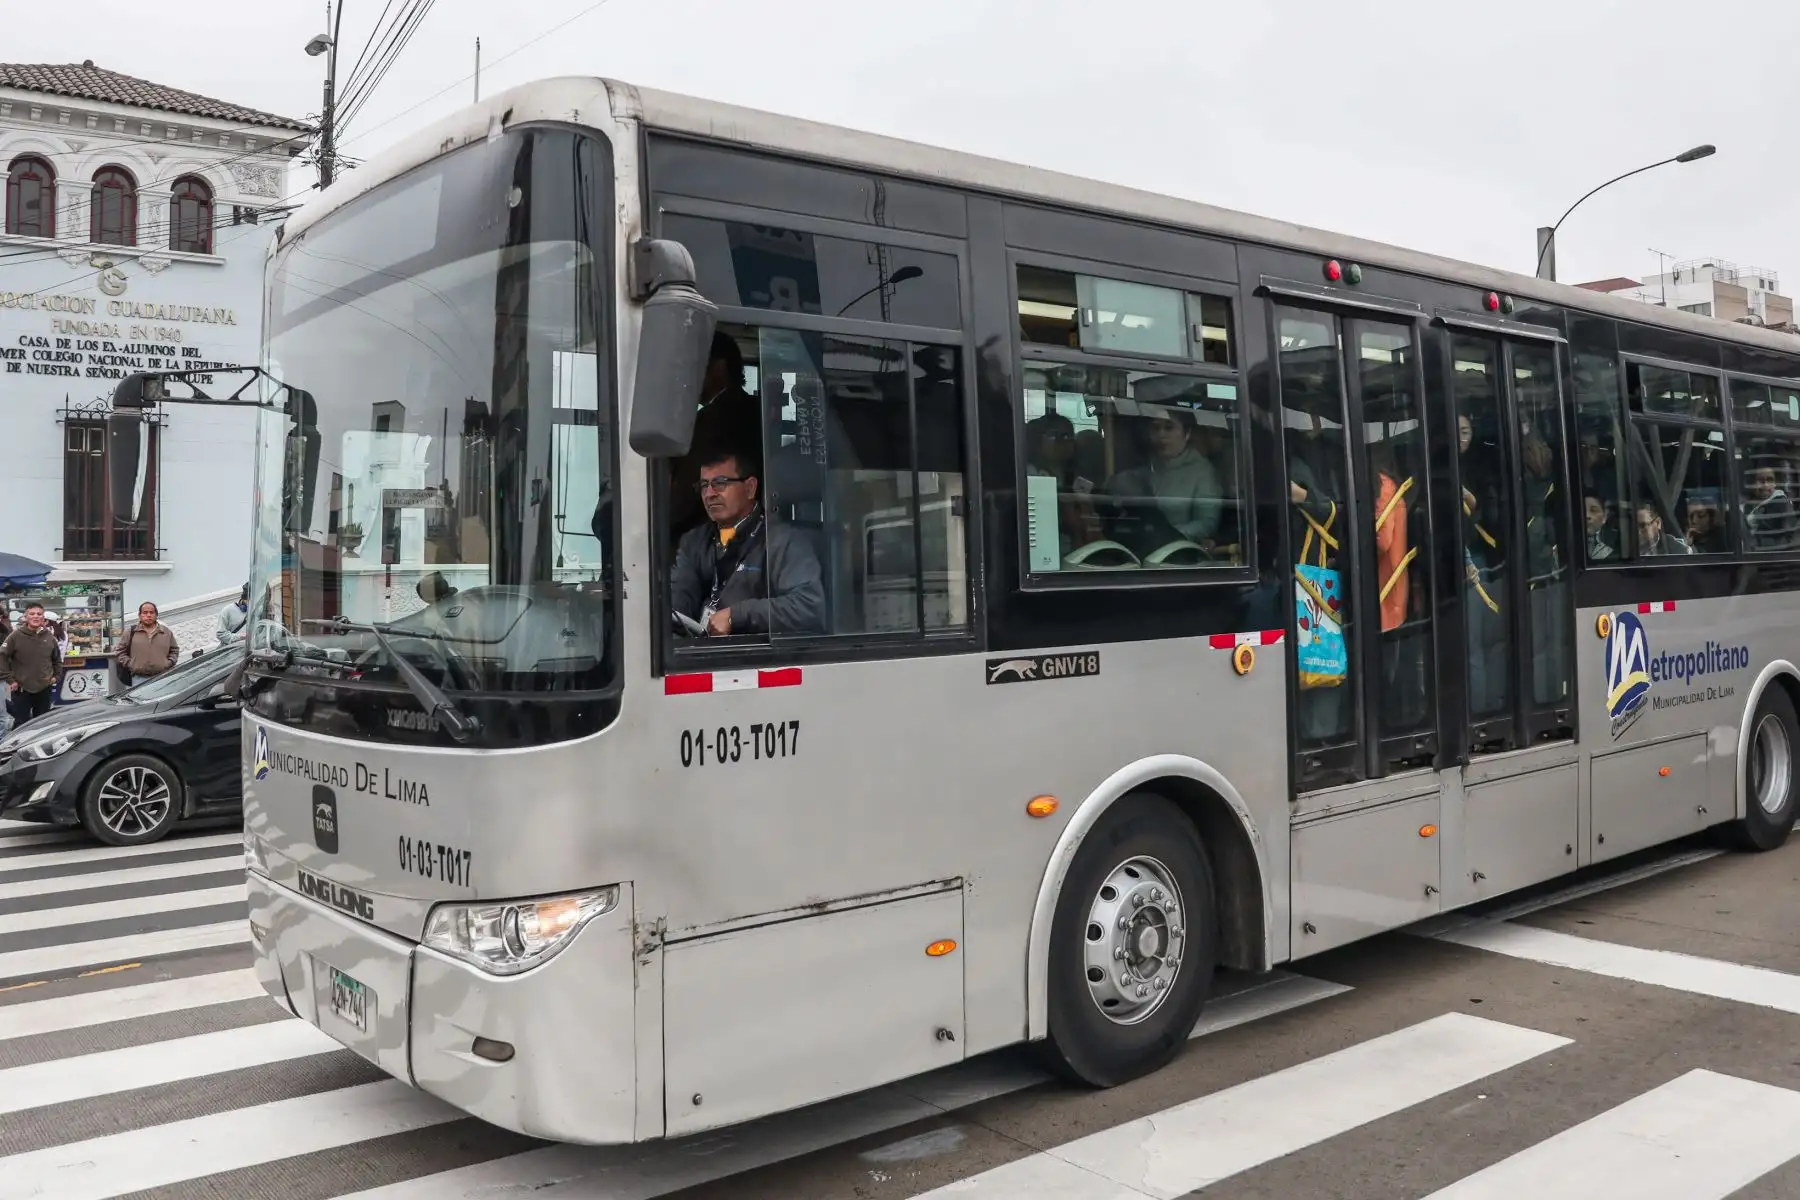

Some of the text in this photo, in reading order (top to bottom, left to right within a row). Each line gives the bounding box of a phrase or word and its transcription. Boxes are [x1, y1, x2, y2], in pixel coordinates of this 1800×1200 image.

[107, 300, 237, 326] GUADALUPANA
[52, 318, 182, 343] FUNDADA EN 1940
[19, 335, 202, 358] CASA DE LOS EX-ALUMNOS DEL
[7, 362, 21, 373] DE
[27, 364, 80, 377] NUESTRA
[86, 366, 128, 380] SEÑORA
[33, 350, 82, 363] COLEGIO
[89, 354, 144, 368] NACIONAL
[148, 358, 161, 369] DE
[166, 359, 180, 370] LA
[1042, 655, 1098, 677] GNV18
[680, 721, 800, 768] 01-03-T017
[315, 816, 335, 833] TATSA
[399, 835, 472, 888] 01-03-T017
[298, 870, 374, 921] KING LONG
